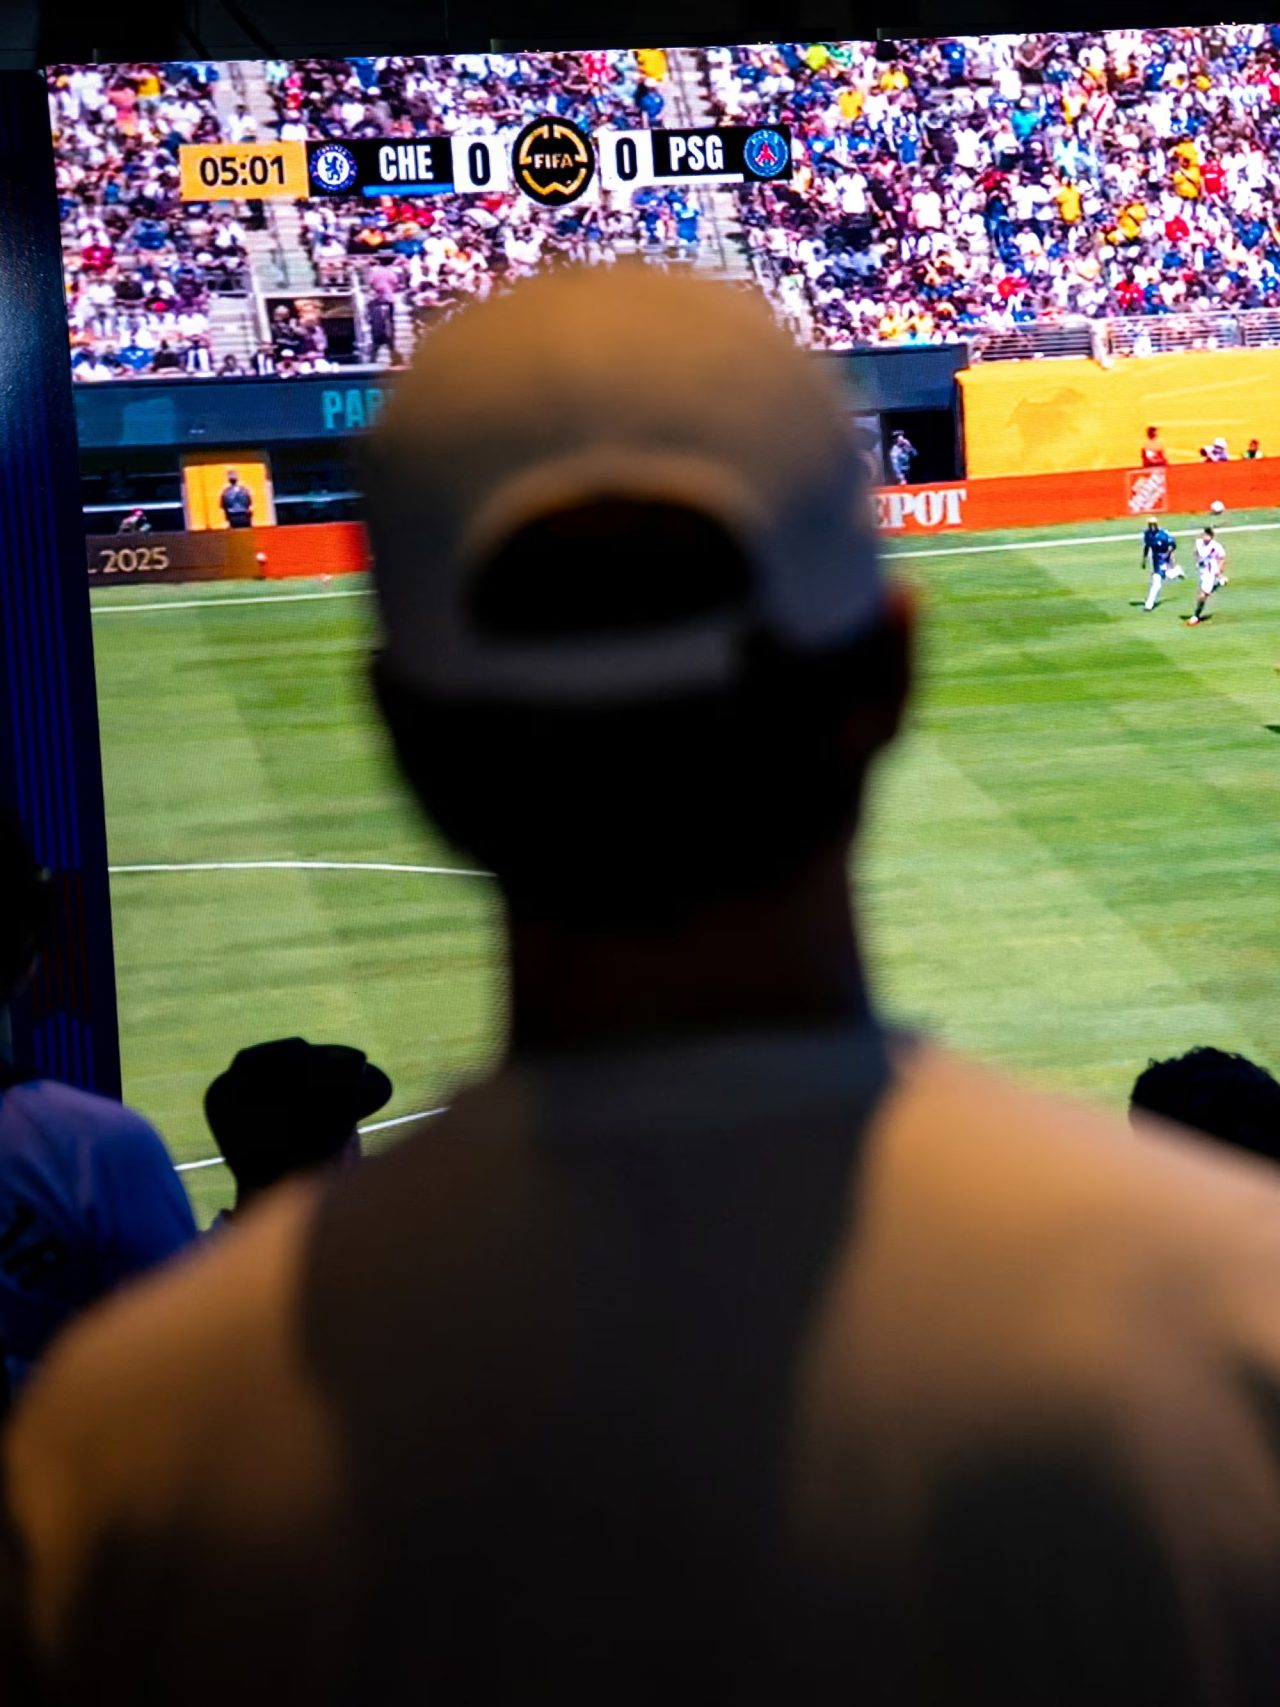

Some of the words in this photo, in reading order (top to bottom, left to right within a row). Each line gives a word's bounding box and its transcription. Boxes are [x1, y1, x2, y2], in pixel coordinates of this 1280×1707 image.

[199, 155, 285, 187] 05:01
[379, 145, 434, 181] CHE
[468, 142, 491, 186] 0
[534, 152, 574, 170] FIFA
[615, 137, 638, 181] 0
[669, 134, 725, 172] PSG
[100, 547, 169, 573] 2025
